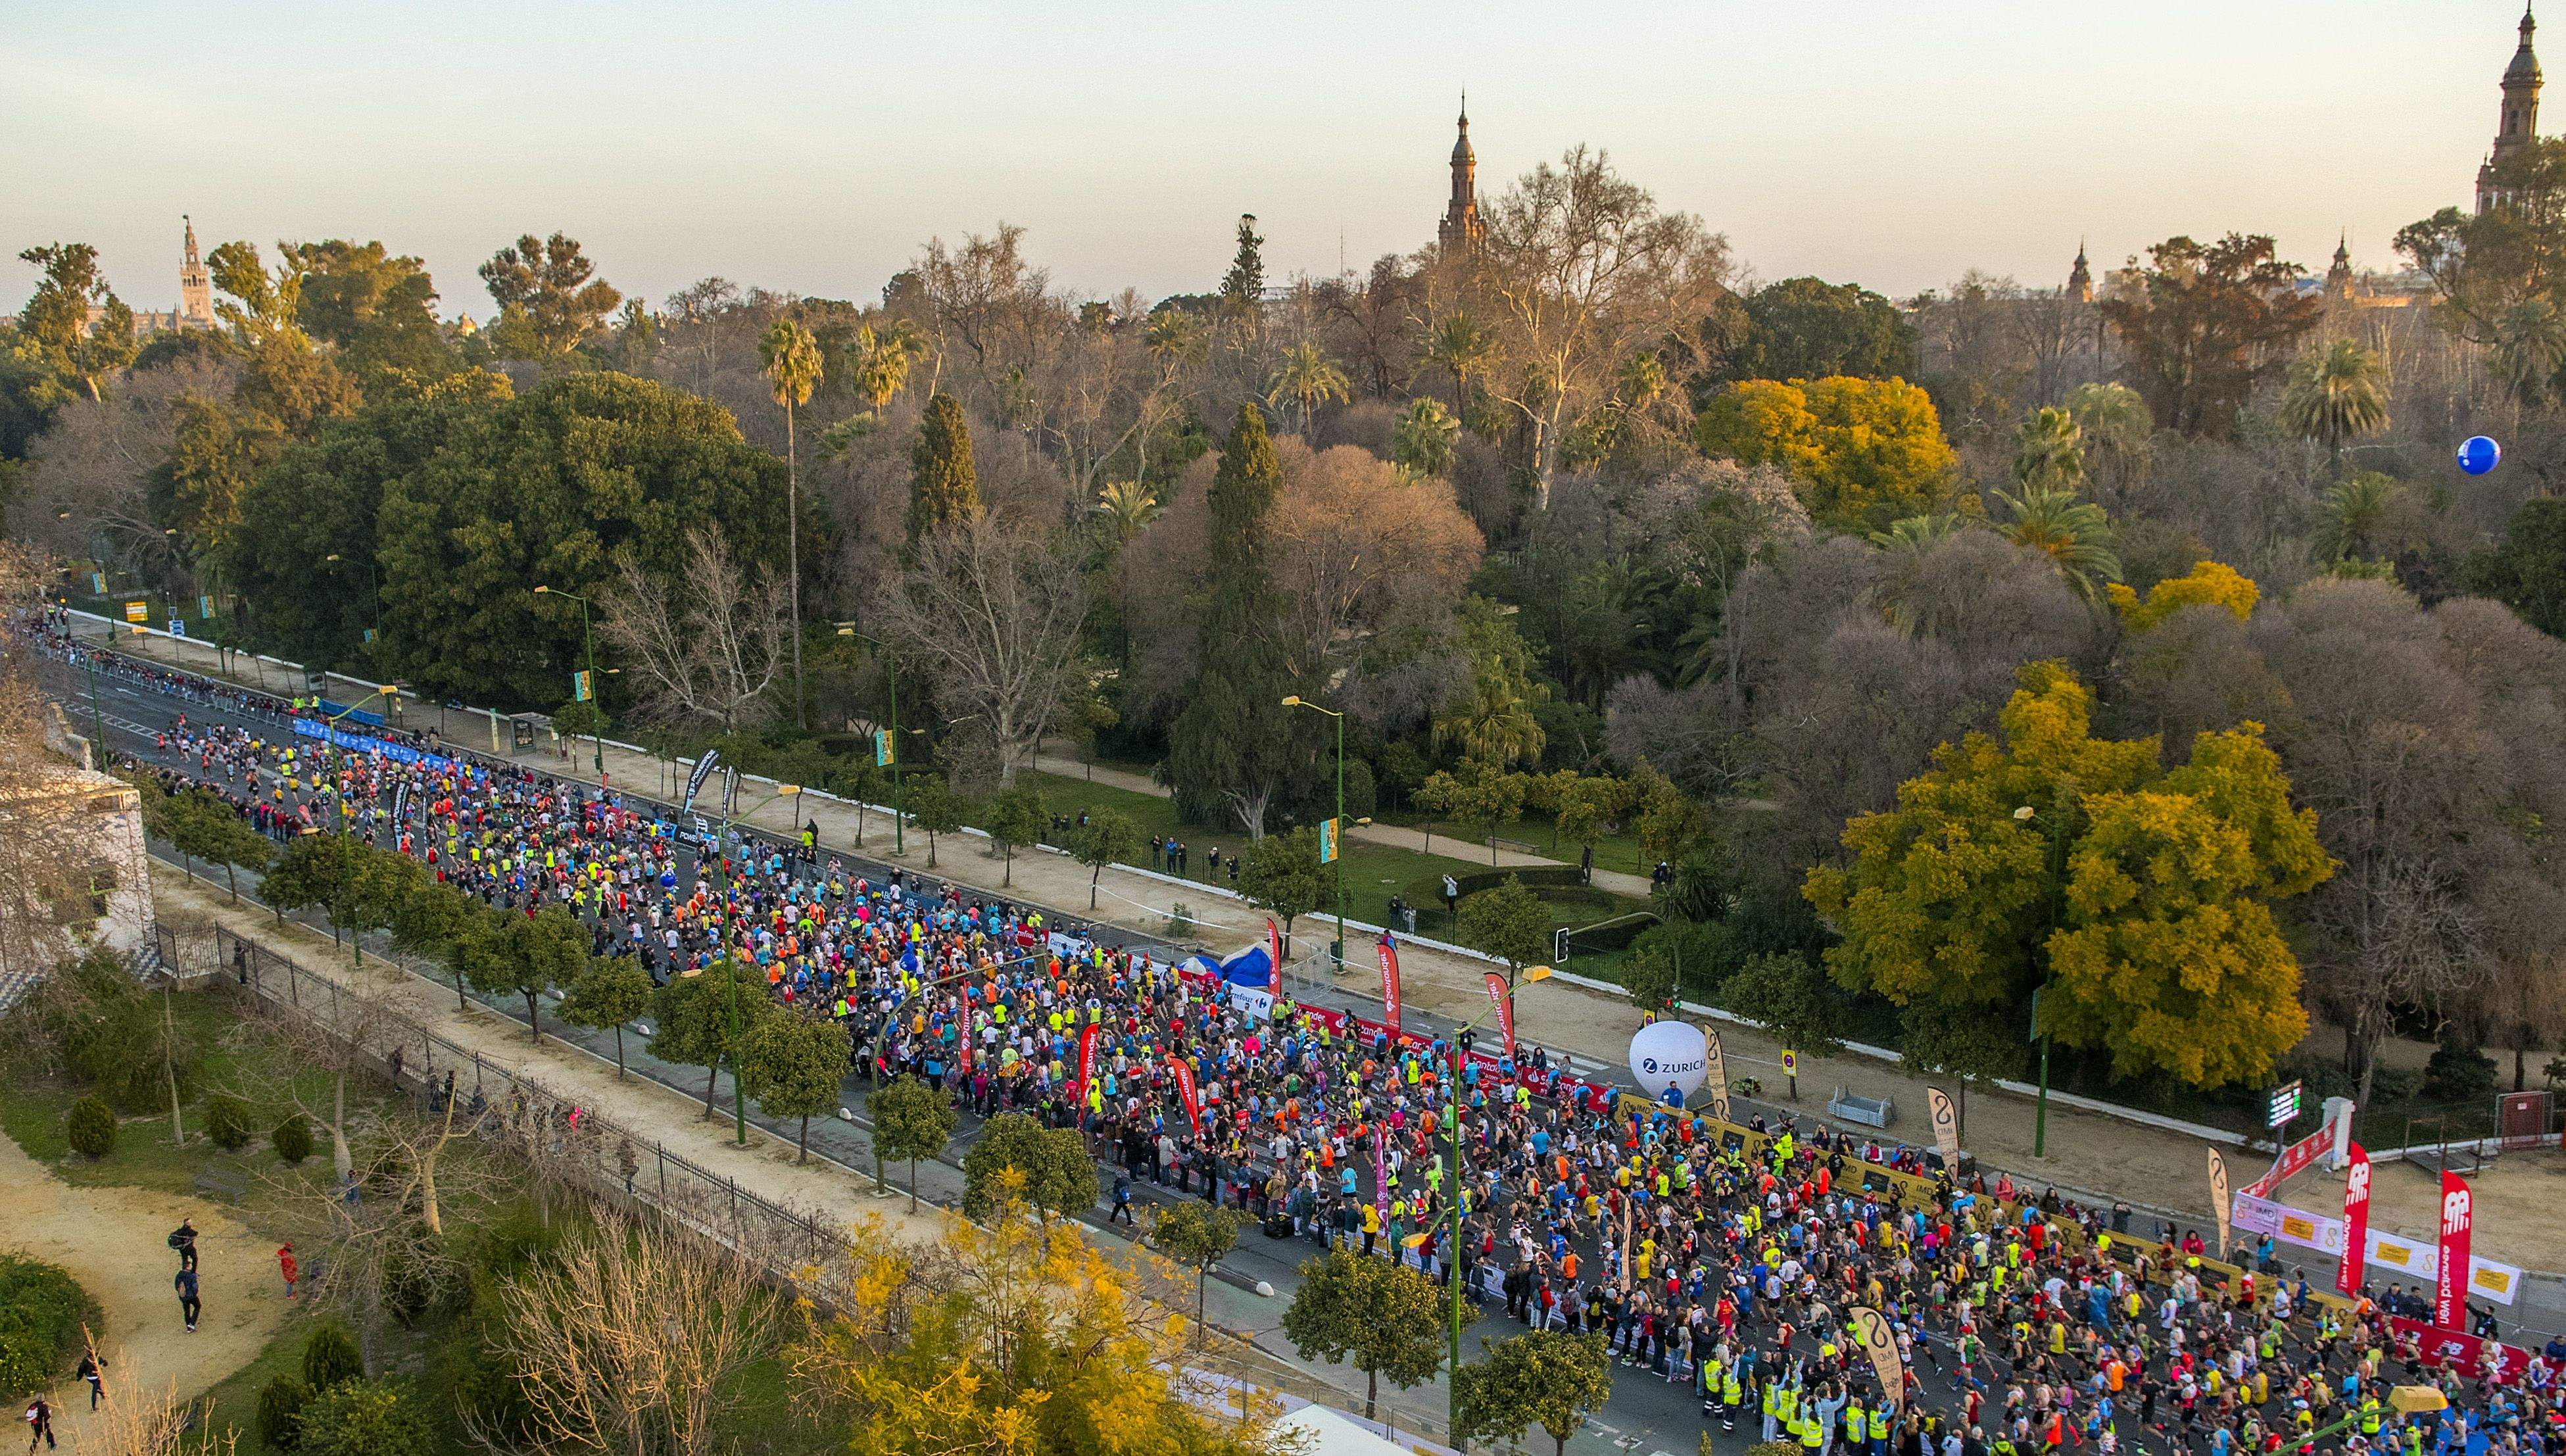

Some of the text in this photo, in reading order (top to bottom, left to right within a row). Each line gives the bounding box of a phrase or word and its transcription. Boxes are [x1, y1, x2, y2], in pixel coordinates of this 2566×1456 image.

[690, 749, 716, 782] POWERADE
[905, 897, 919, 908] ABC
[1230, 992, 1253, 1003] rrefour
[1662, 1059, 1706, 1073] ZURICH
